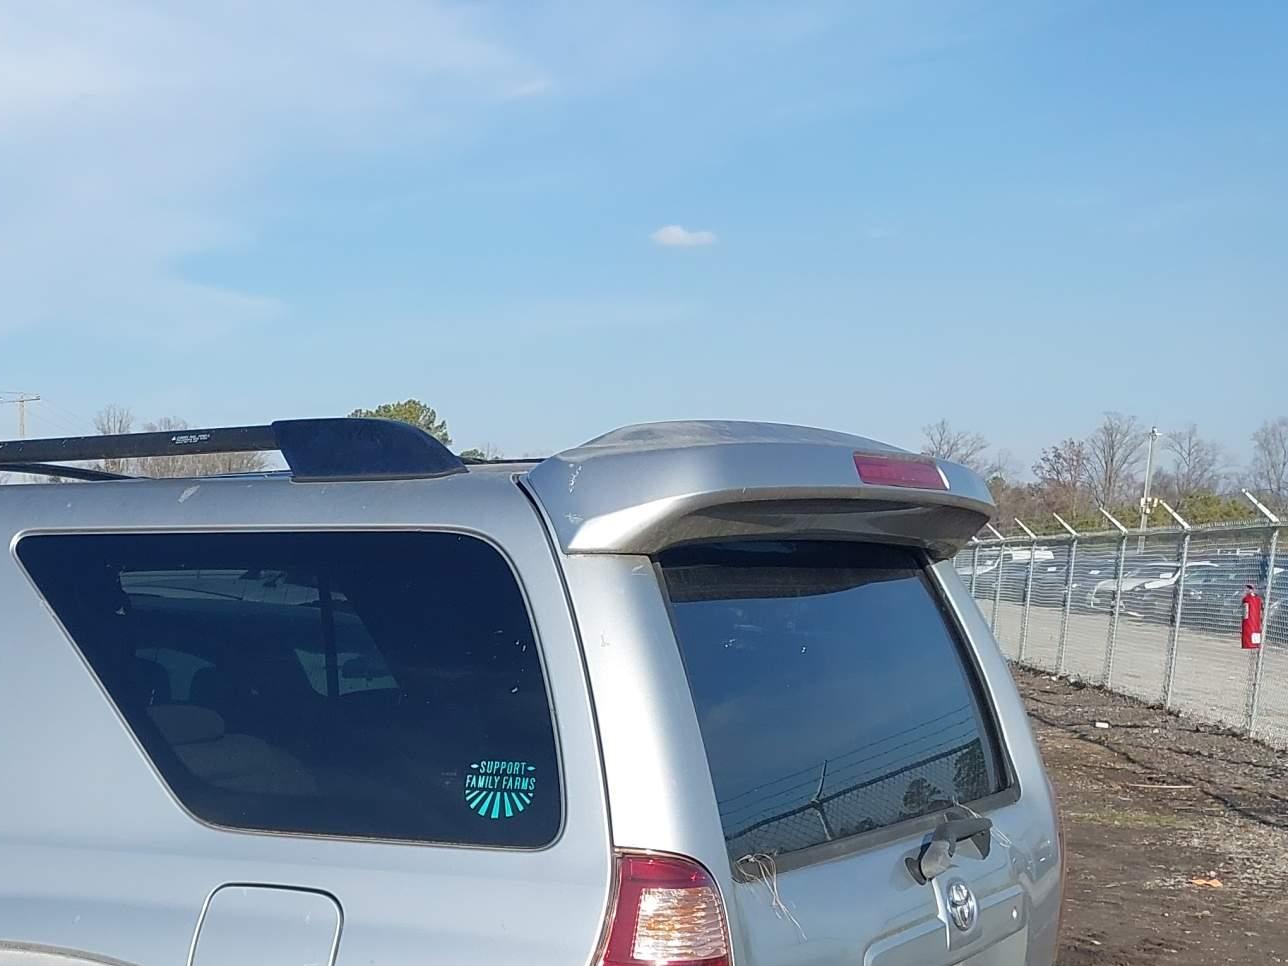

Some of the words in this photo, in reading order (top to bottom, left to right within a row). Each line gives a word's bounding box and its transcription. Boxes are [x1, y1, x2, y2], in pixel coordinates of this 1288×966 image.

[479, 760, 527, 775] SUPPORT
[465, 774, 501, 789] FAMILY
[501, 776, 537, 791] FARMS
